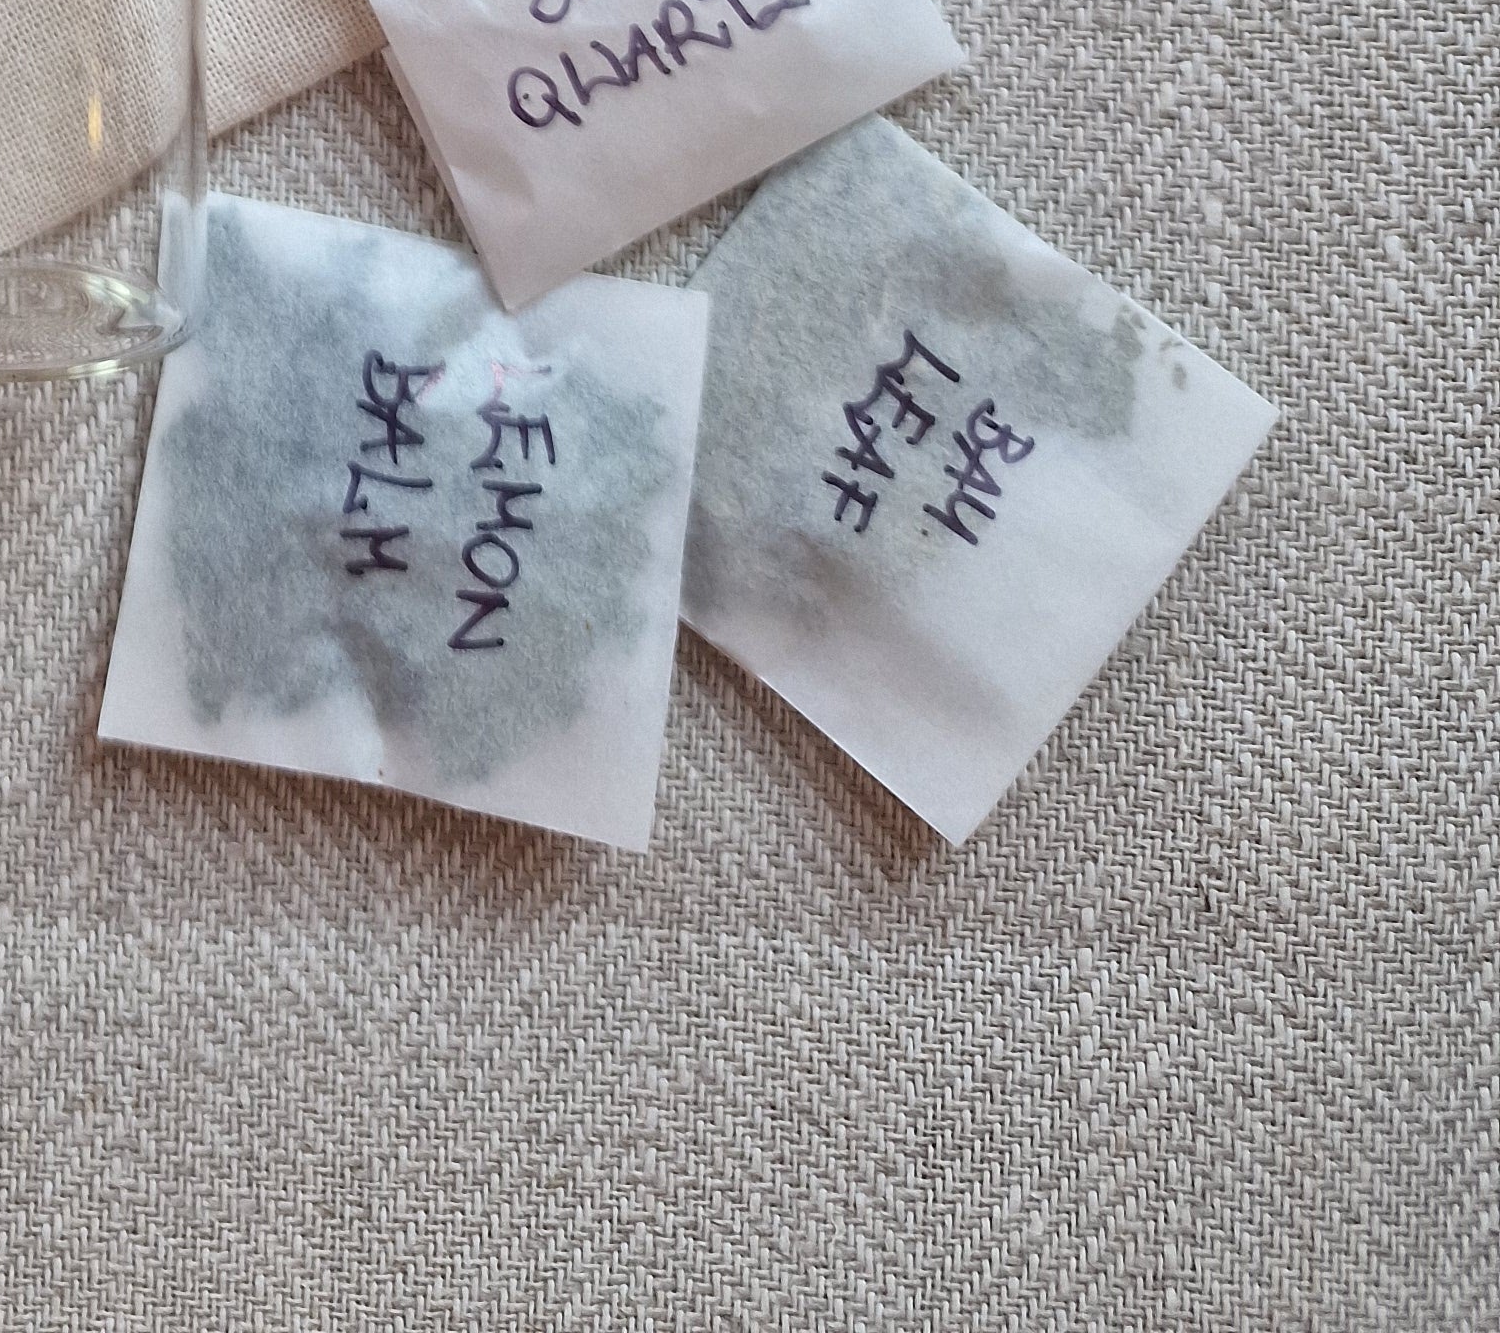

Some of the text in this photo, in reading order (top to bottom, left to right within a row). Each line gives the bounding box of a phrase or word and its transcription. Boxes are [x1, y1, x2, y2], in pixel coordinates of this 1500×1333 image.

[340, 348, 447, 576] BALM
[446, 359, 556, 650] LEMON
[821, 329, 961, 534] LEAF
[923, 397, 1035, 546] BAY
